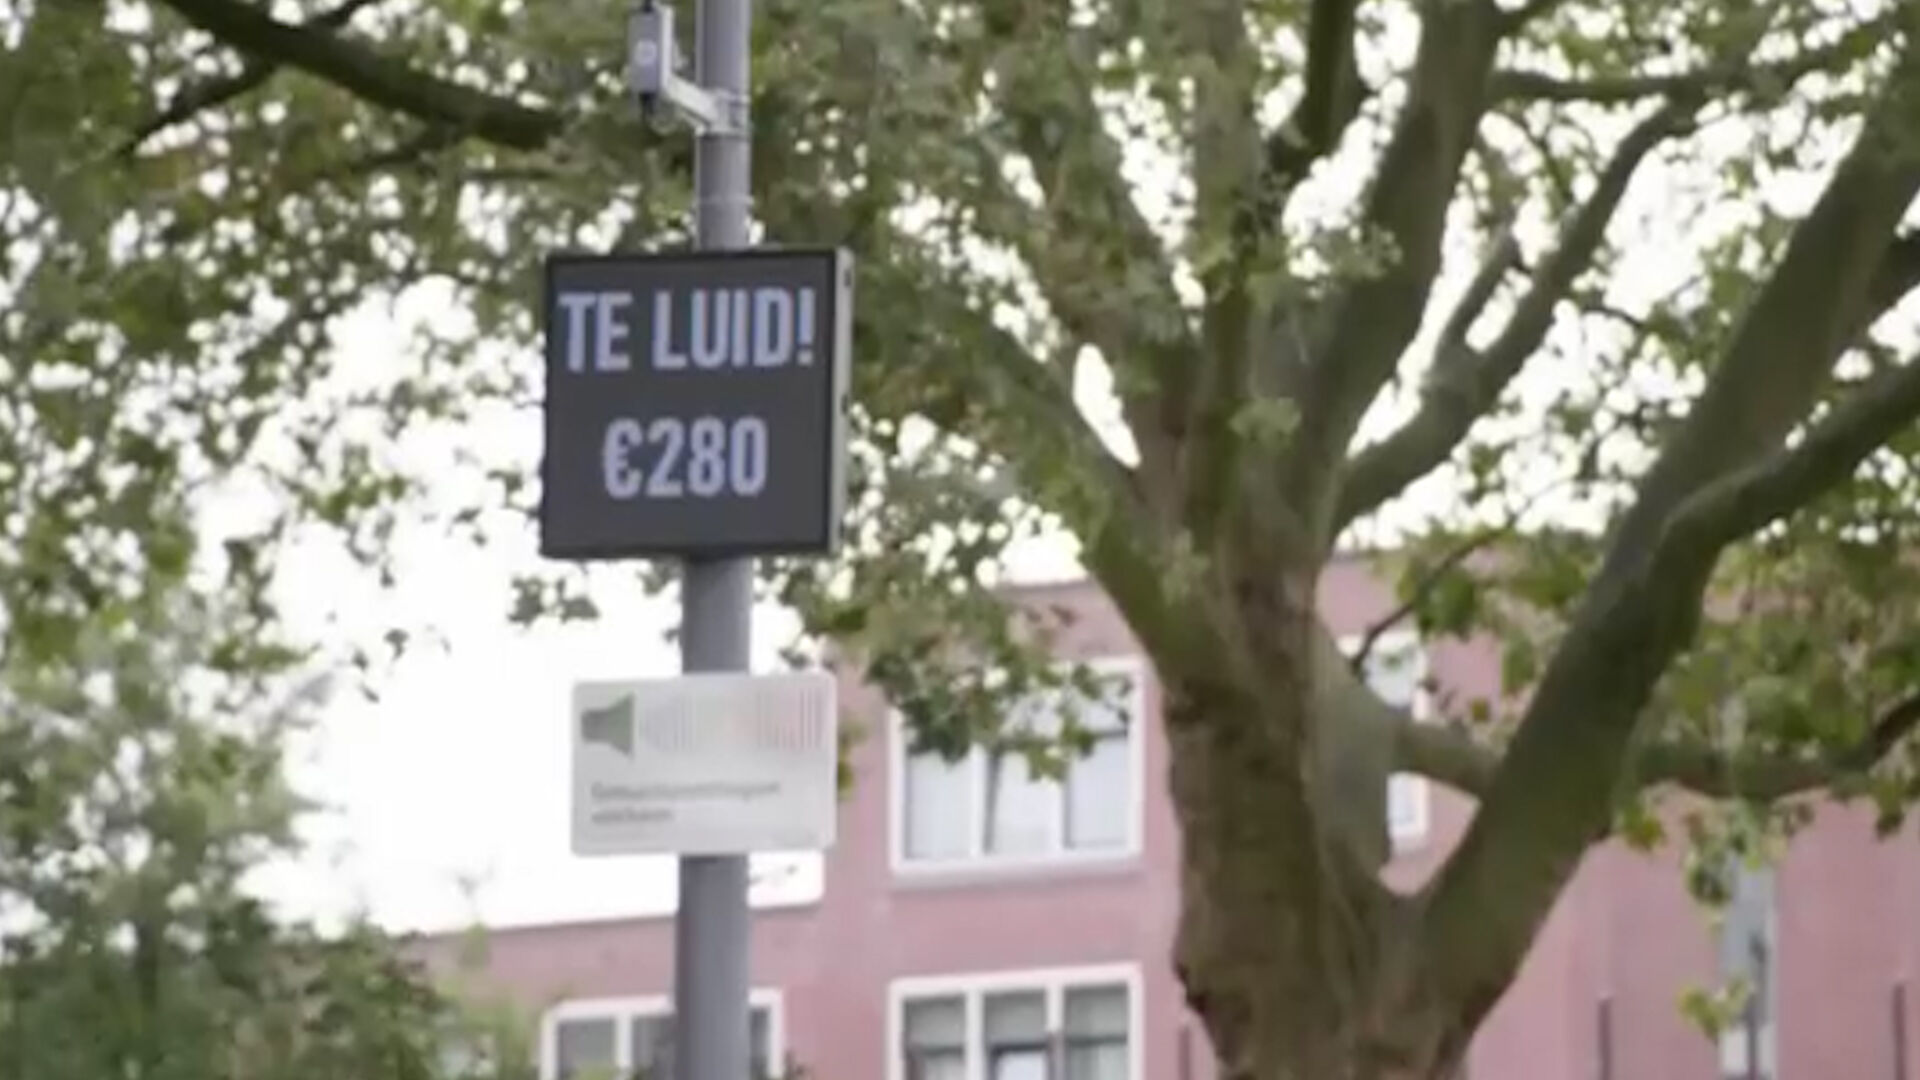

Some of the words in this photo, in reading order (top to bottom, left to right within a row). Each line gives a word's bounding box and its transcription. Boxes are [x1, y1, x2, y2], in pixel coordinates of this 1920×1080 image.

[558, 291, 633, 372] TE
[653, 287, 815, 369] LUID!
[604, 416, 767, 498] €280
